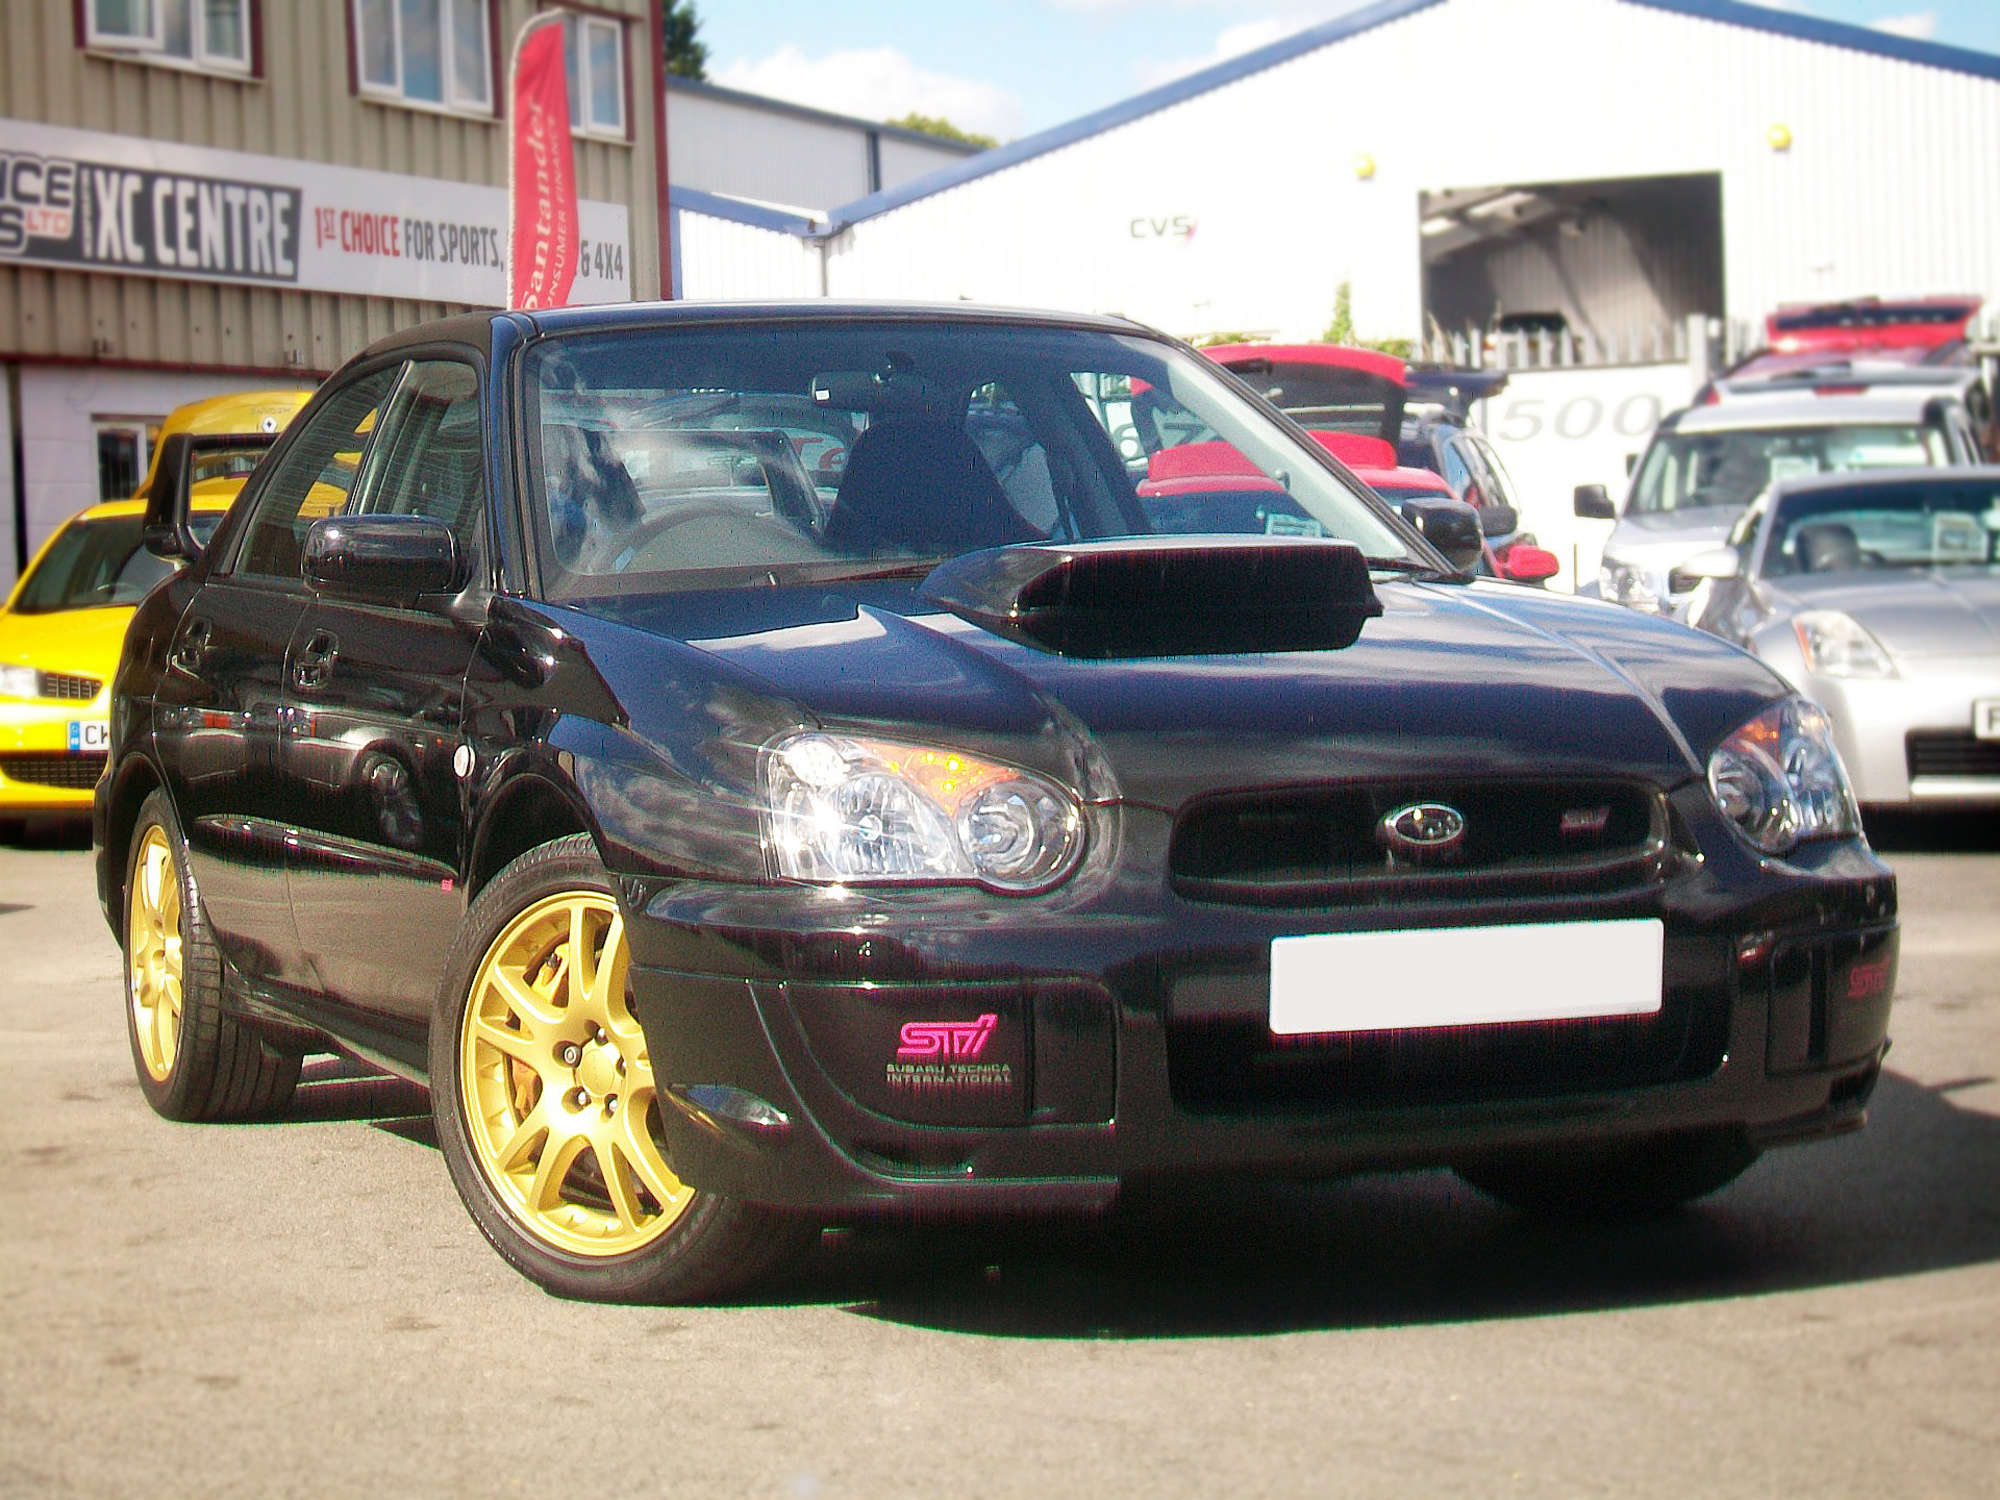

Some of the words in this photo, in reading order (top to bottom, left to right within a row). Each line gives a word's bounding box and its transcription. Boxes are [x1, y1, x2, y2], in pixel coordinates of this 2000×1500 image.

[153, 177, 294, 277] CENTRE
[340, 209, 401, 257] CHOICE
[404, 217, 435, 262] FOR
[1130, 215, 1192, 239] CVS
[886, 1063, 945, 1073] SUBARU
